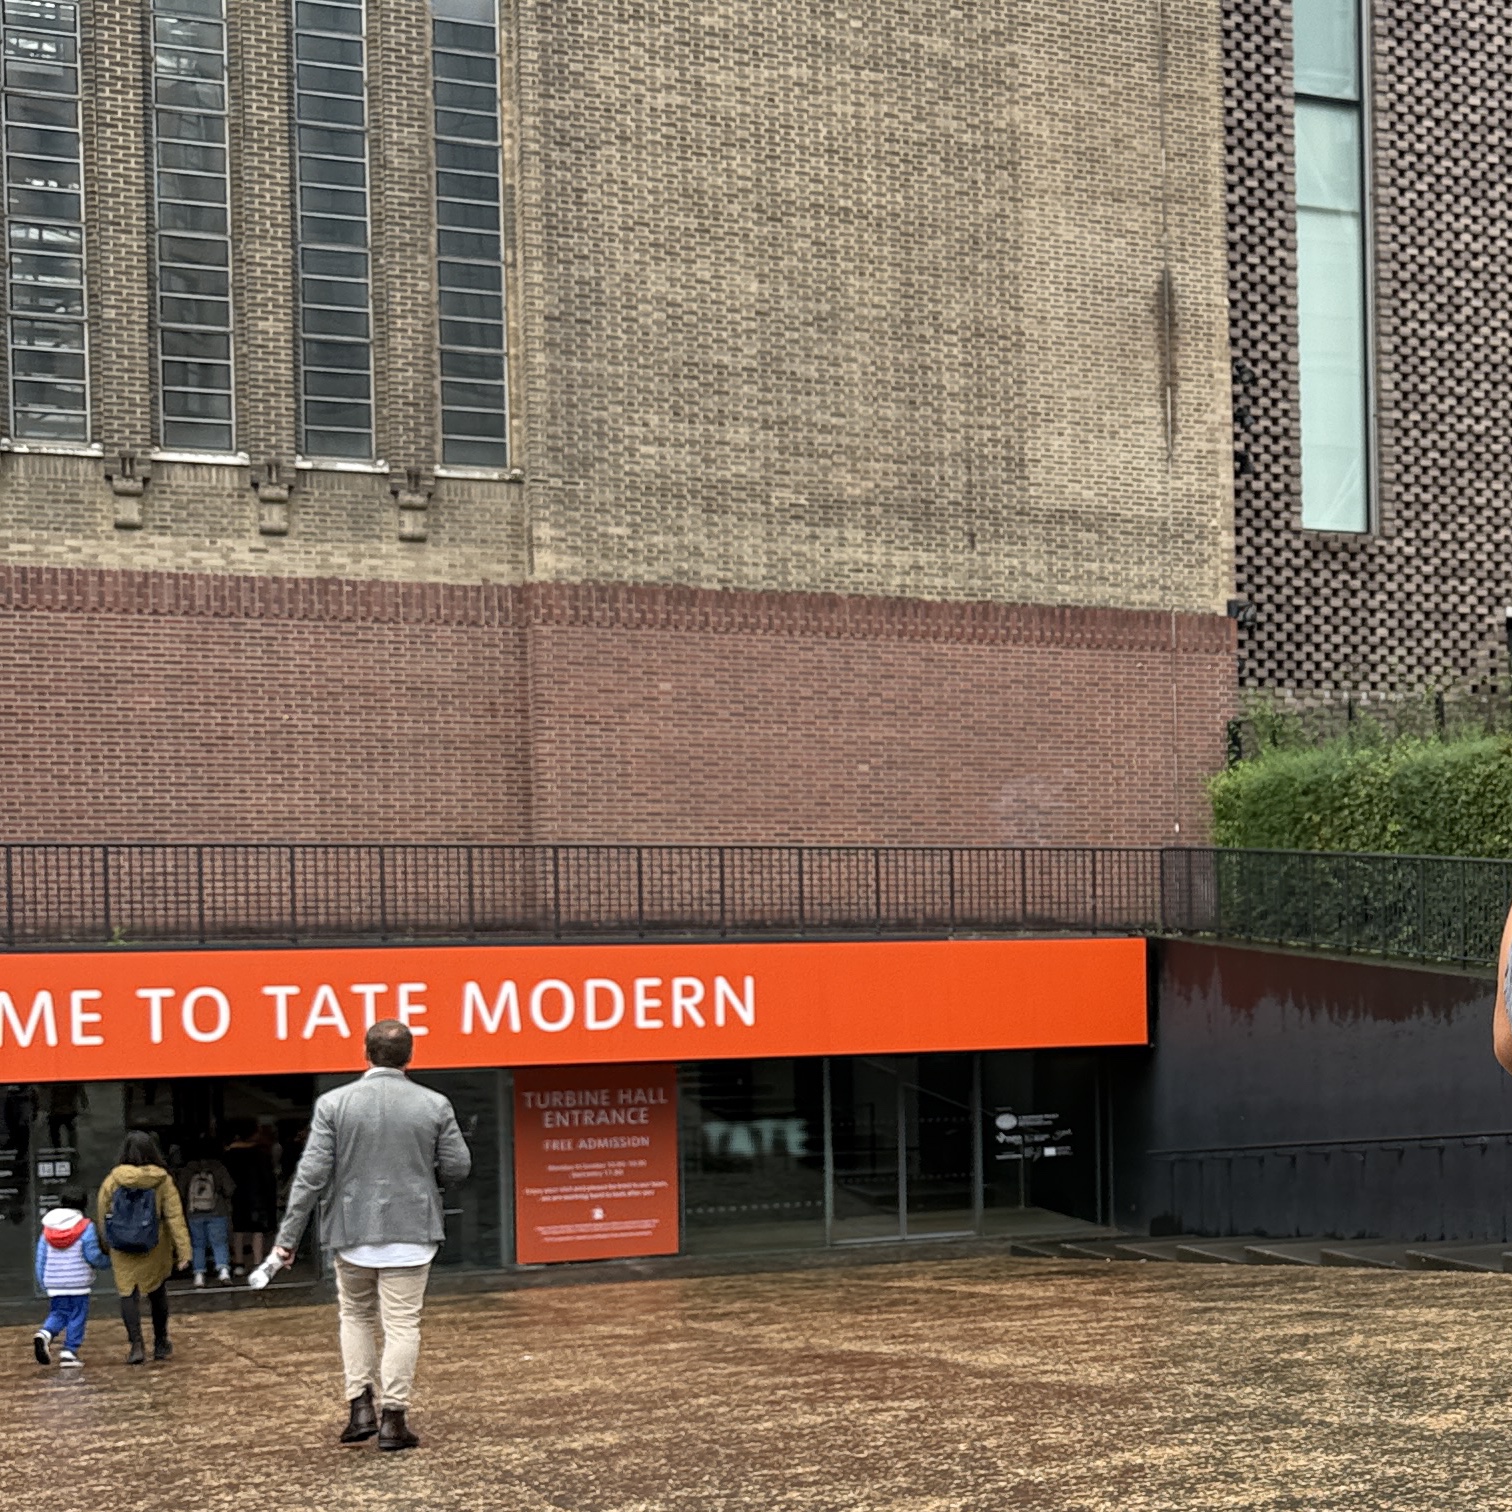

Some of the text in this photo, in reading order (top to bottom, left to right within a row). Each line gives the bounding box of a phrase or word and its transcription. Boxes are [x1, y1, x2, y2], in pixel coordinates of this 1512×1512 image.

[136, 986, 231, 1044] TO
[261, 983, 429, 1040] TATE
[461, 975, 755, 1035] MODERN
[524, 1087, 668, 1109] TURBINE HALL
[543, 1107, 650, 1128] ENTRANCE
[544, 1135, 650, 1151] FREE ADMISSION
